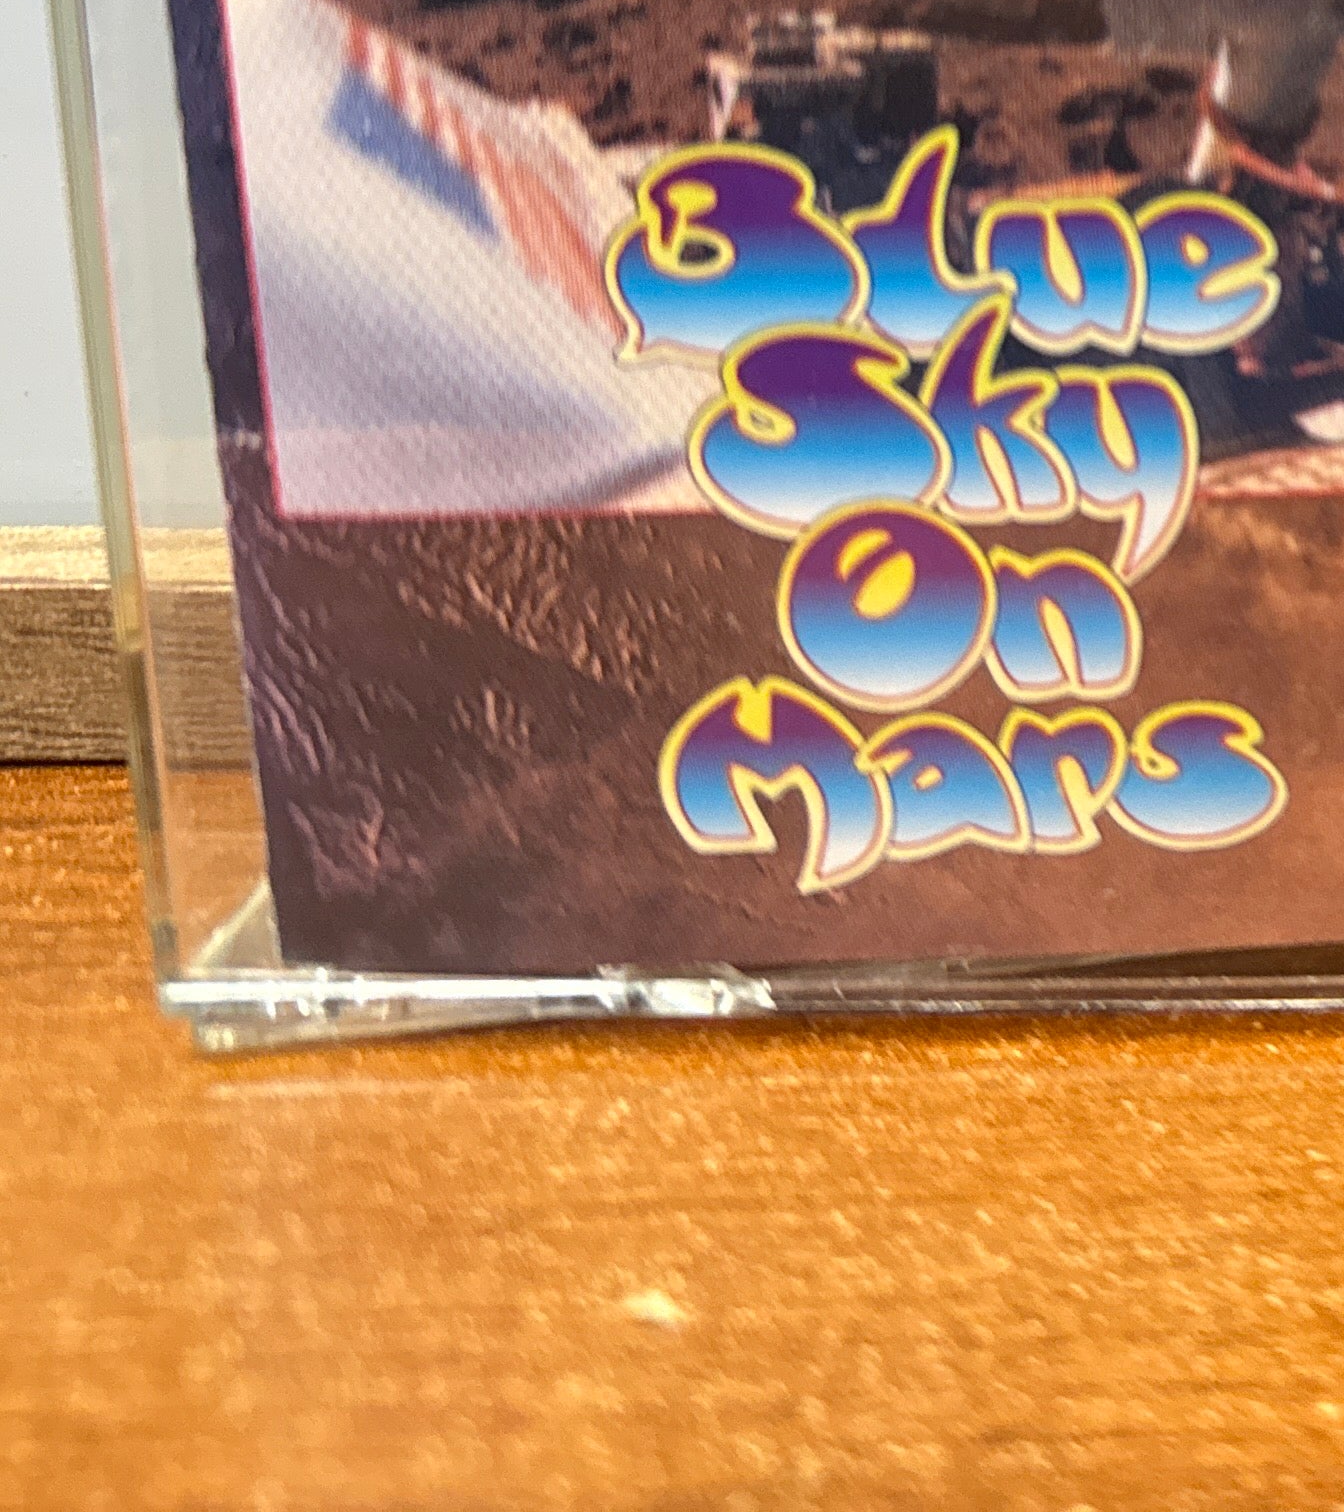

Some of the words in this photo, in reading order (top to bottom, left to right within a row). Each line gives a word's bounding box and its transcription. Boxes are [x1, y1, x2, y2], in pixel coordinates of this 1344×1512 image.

[605, 124, 1281, 369] Blue
[688, 292, 1200, 585] Sky
[778, 497, 1142, 712] On
[659, 675, 1288, 894] Mars
